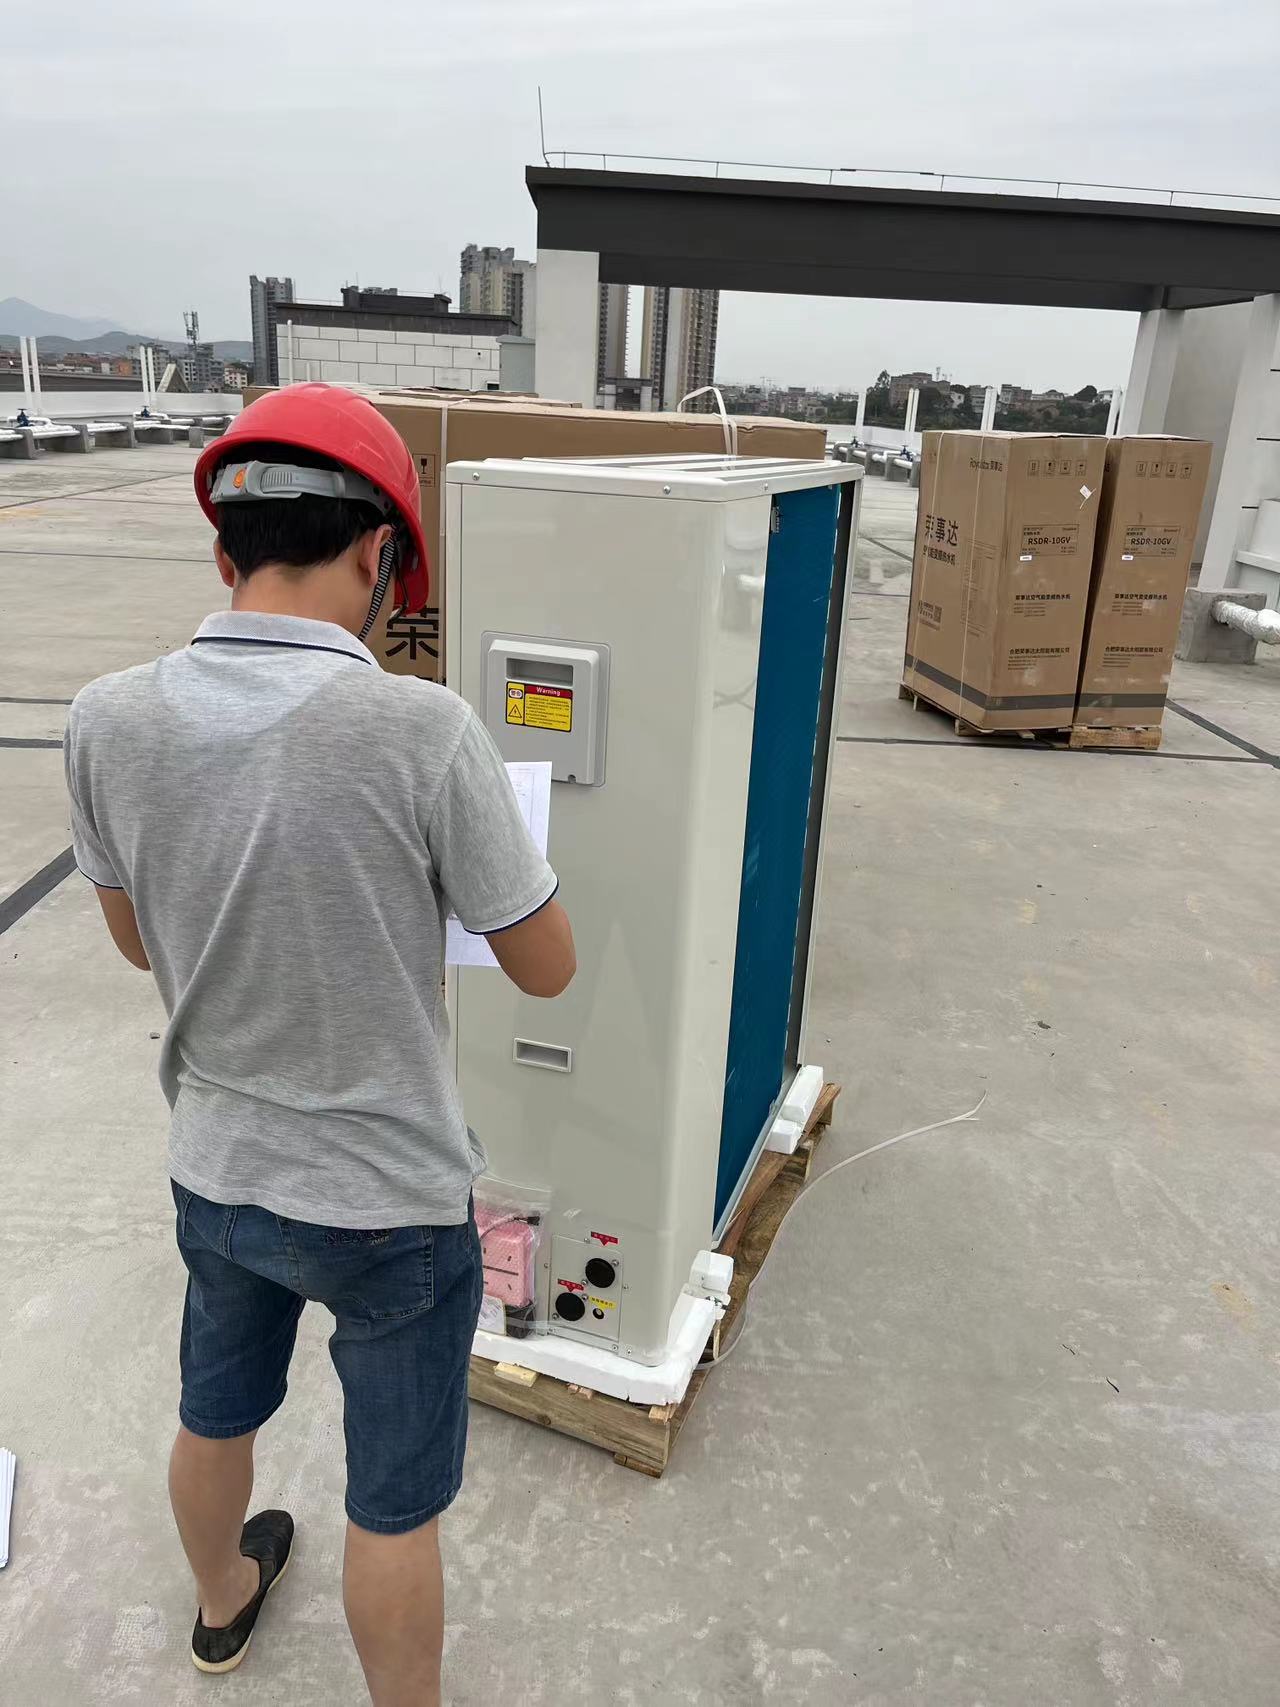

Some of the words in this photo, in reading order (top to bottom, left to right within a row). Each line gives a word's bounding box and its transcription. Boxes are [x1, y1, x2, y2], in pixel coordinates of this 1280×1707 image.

[1027, 536, 1071, 546] RSDR-10GV
[1130, 537, 1172, 546] RSDR-10GV
[535, 686, 561, 697] Warning
